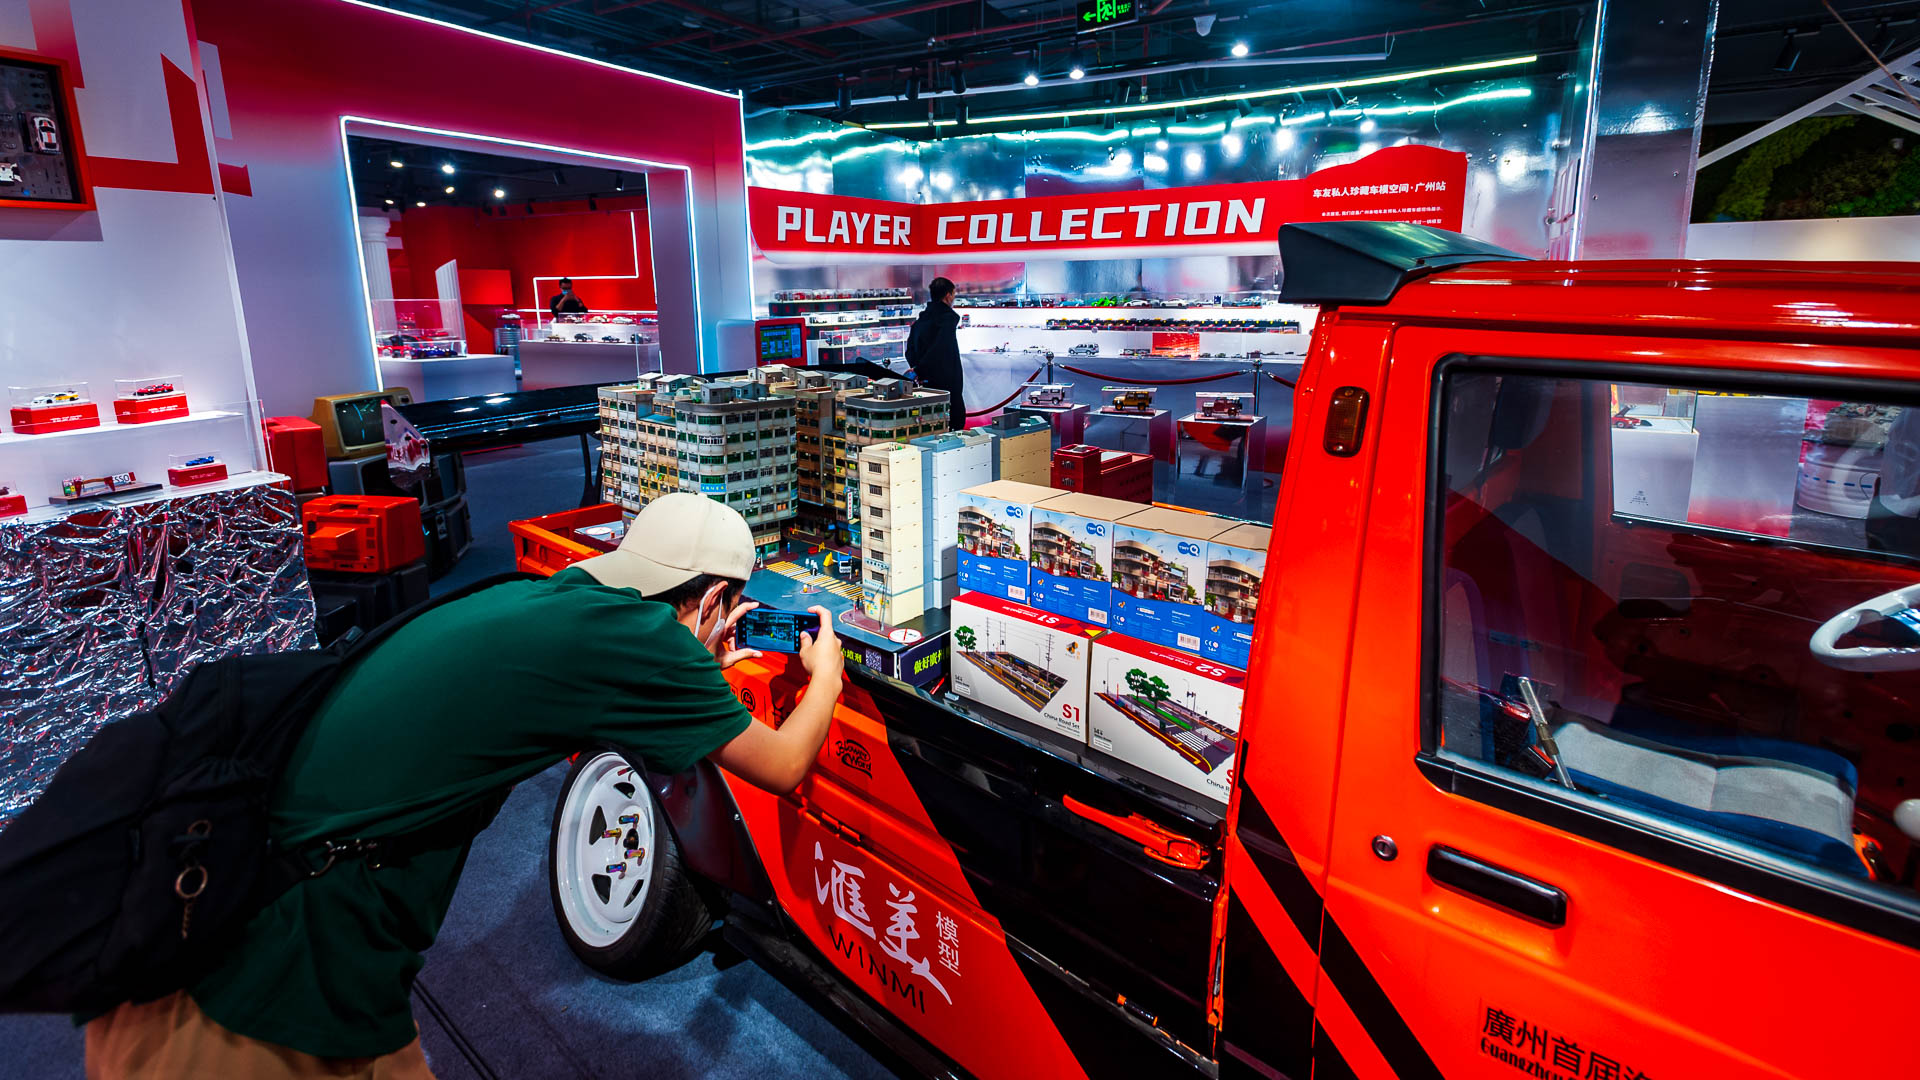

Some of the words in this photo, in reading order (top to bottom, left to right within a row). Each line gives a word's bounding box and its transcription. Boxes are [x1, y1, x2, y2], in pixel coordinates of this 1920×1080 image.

[777, 205, 911, 246] PLAYER
[936, 198, 1266, 246] COLLECTION
[1043, 712, 1058, 721] China
[1058, 717, 1072, 726] Road
[1062, 703, 1080, 722] S1
[1206, 778, 1225, 789] China
[935, 911, 962, 977] 模型
[828, 924, 926, 1014] WINMI
[1483, 1006, 1654, 1080] 廣州首屆
